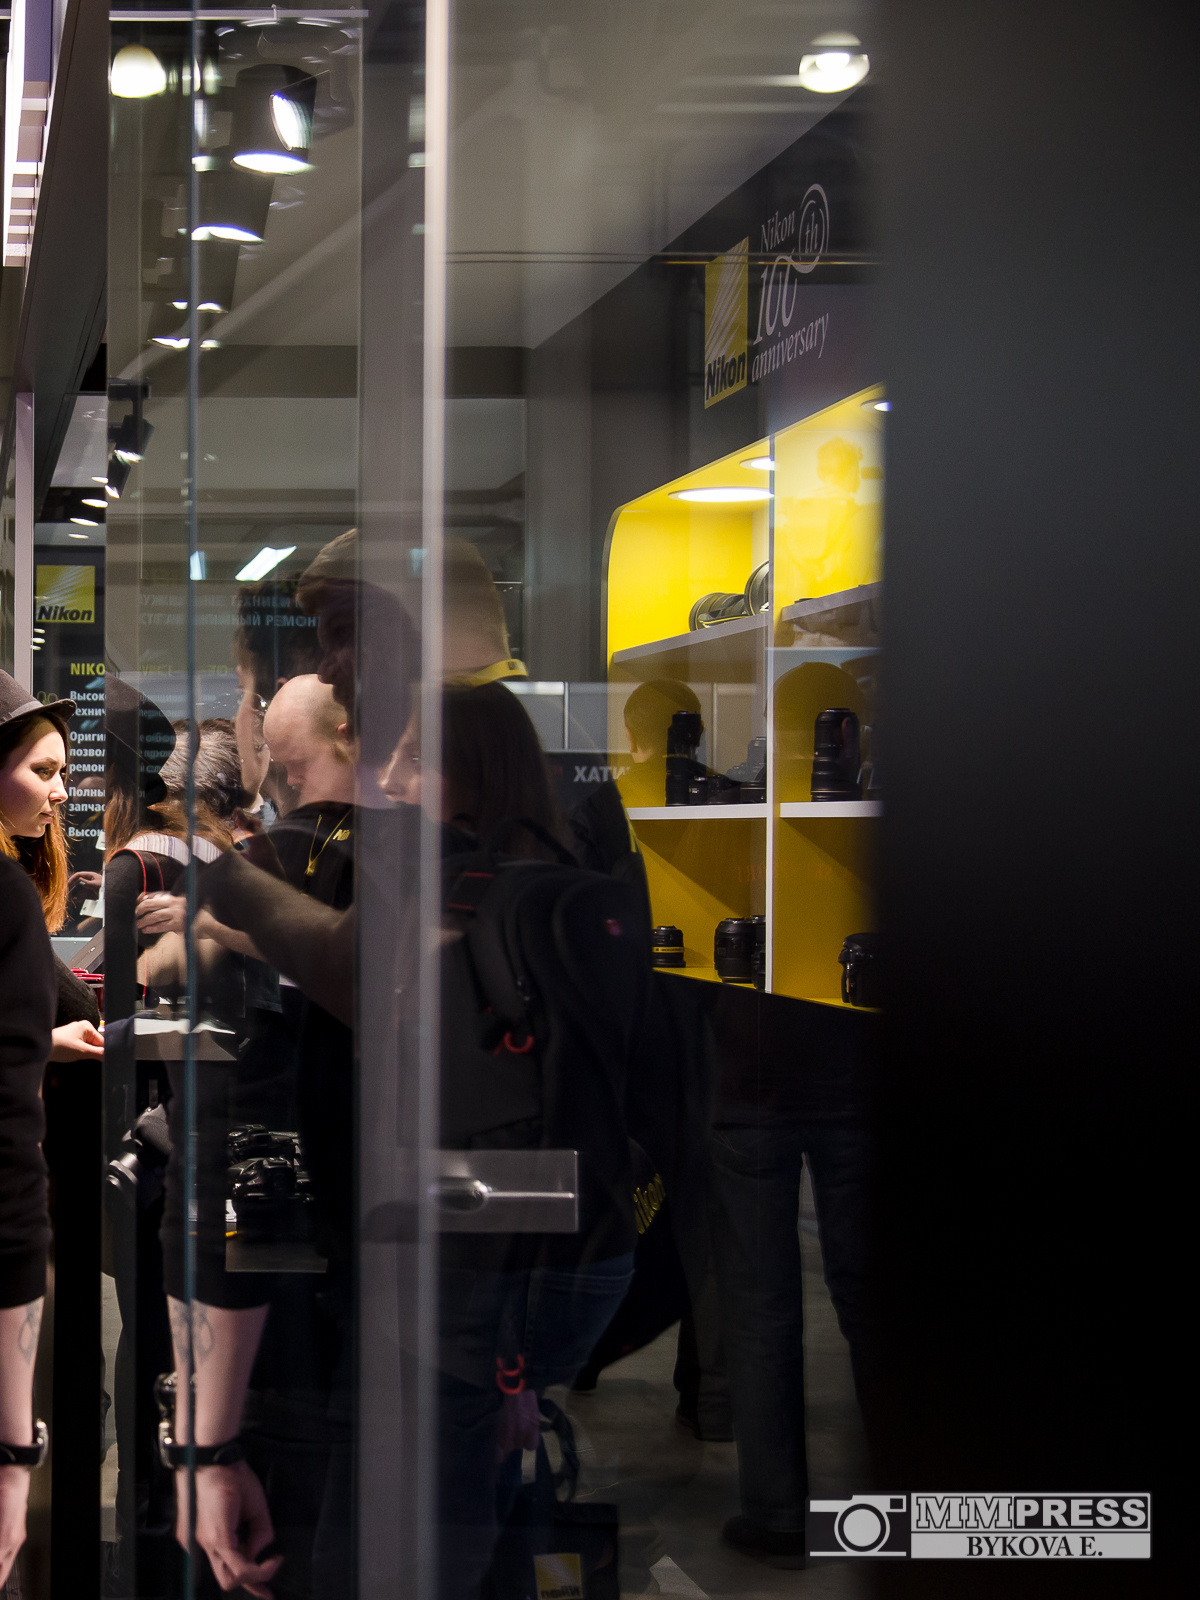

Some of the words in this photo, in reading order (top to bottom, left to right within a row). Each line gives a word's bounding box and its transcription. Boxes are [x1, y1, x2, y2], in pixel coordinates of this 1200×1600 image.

[761, 211, 796, 253] Nikon
[752, 313, 829, 383] anniversary
[706, 352, 746, 399] Nikon
[38, 605, 93, 621] Nikon
[70, 662, 105, 676] NIKO
[70, 690, 106, 701] Высок
[69, 748, 106, 757] позвол
[69, 763, 106, 775] ремон
[69, 786, 106, 797] Полны
[69, 803, 106, 812] запчас
[632, 1172, 667, 1235] ikon
